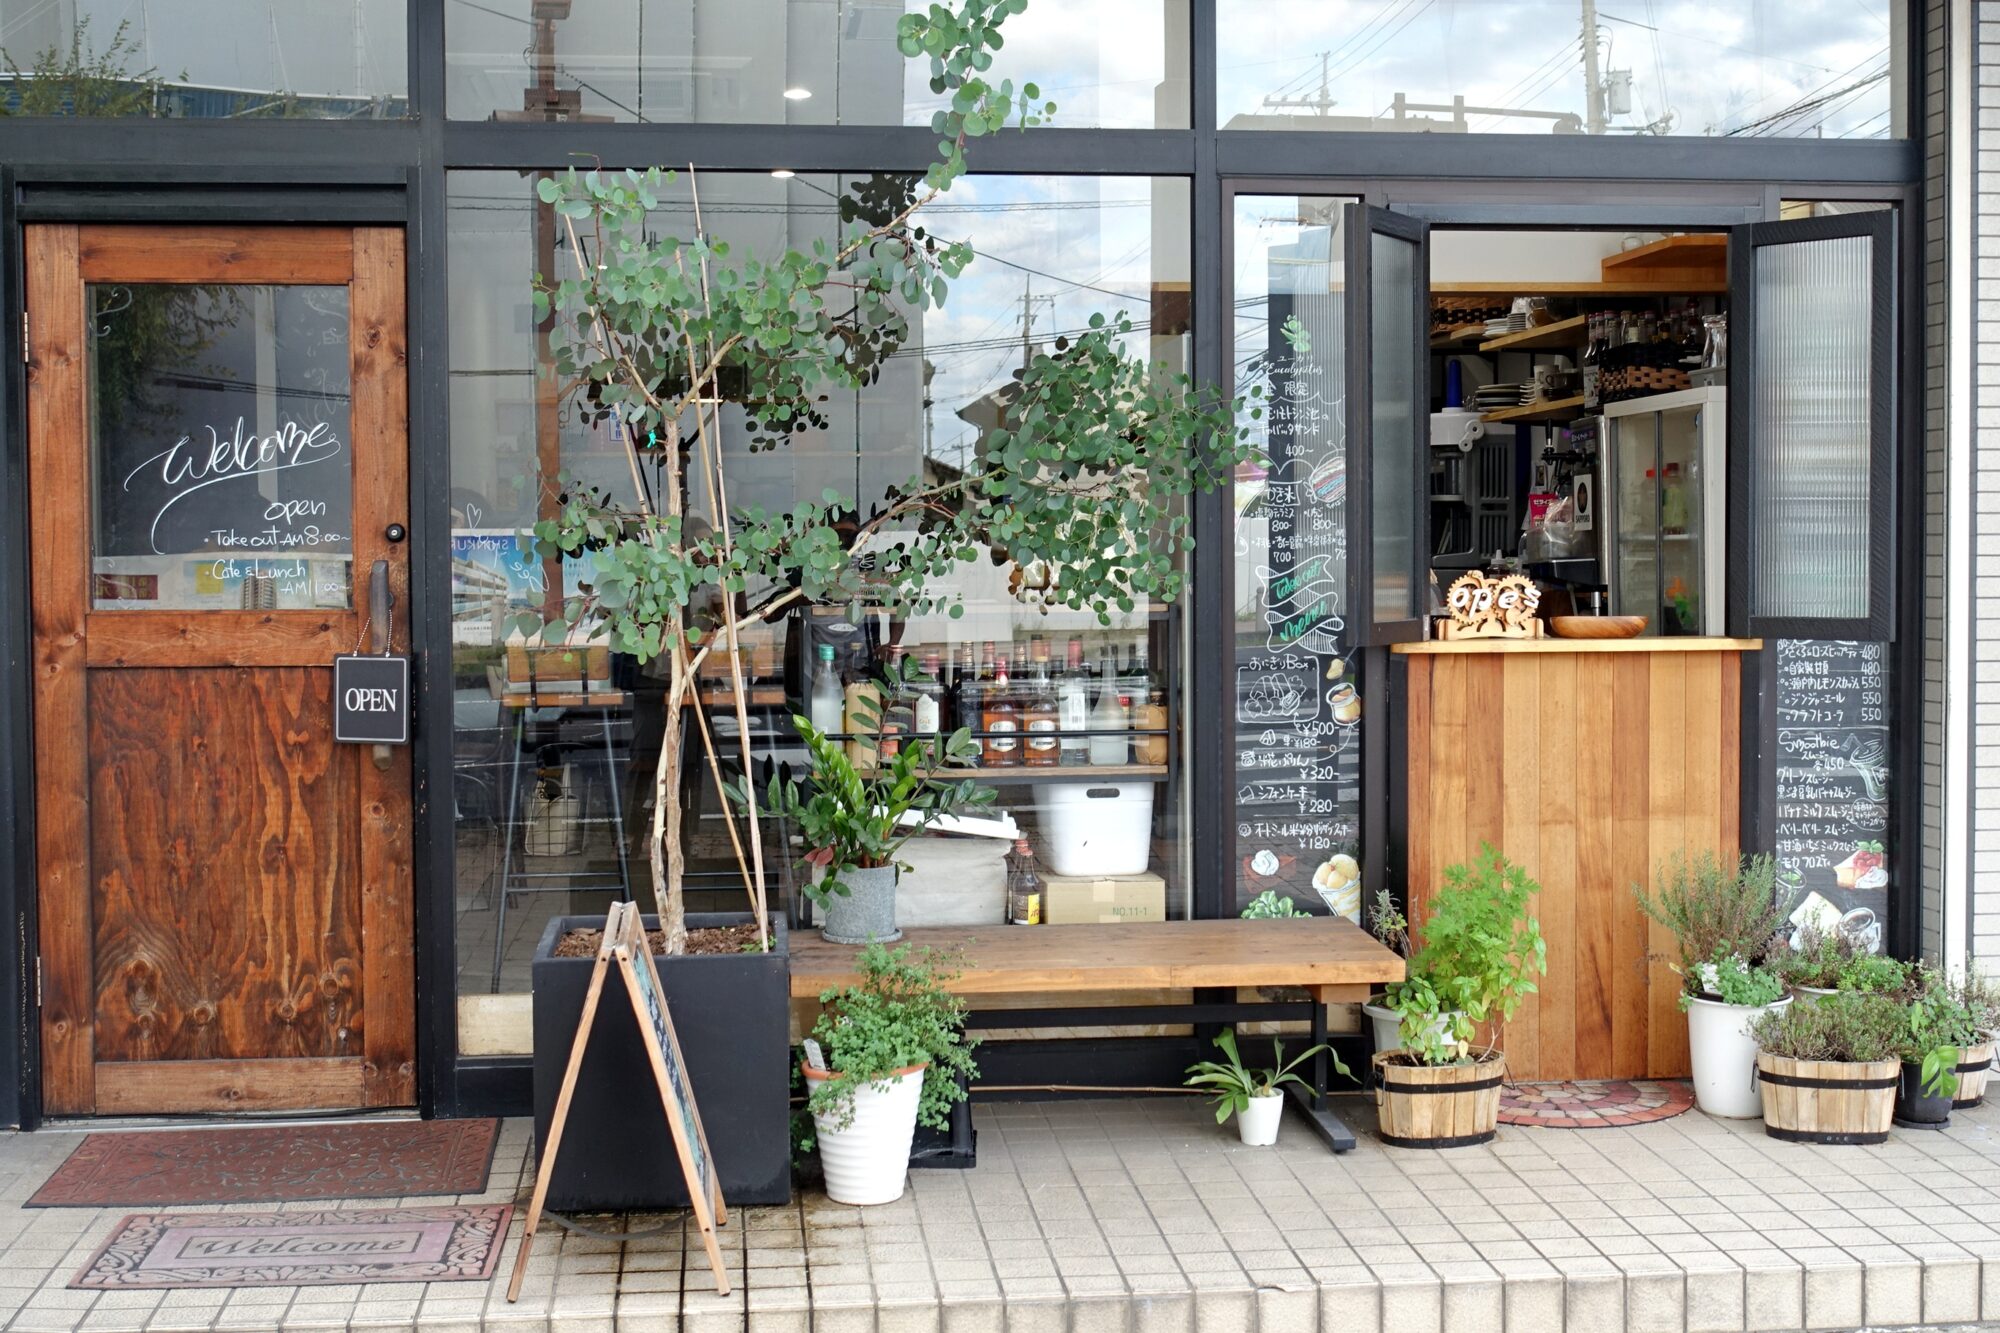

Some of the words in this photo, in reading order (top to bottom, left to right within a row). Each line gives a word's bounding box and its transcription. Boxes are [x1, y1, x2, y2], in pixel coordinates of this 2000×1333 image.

[124, 416, 341, 491] Welcome
[264, 500, 326, 524] open
[256, 558, 305, 579] Lunch
[1861, 645, 1880, 660] 480
[1861, 661, 1880, 675] 480
[1861, 676, 1881, 688] 550
[345, 687, 398, 712] OPEN
[1862, 691, 1881, 705] 550
[1861, 707, 1881, 721] 550
[1779, 731, 1840, 752] Smoothie
[195, 1236, 406, 1255] Welcome
